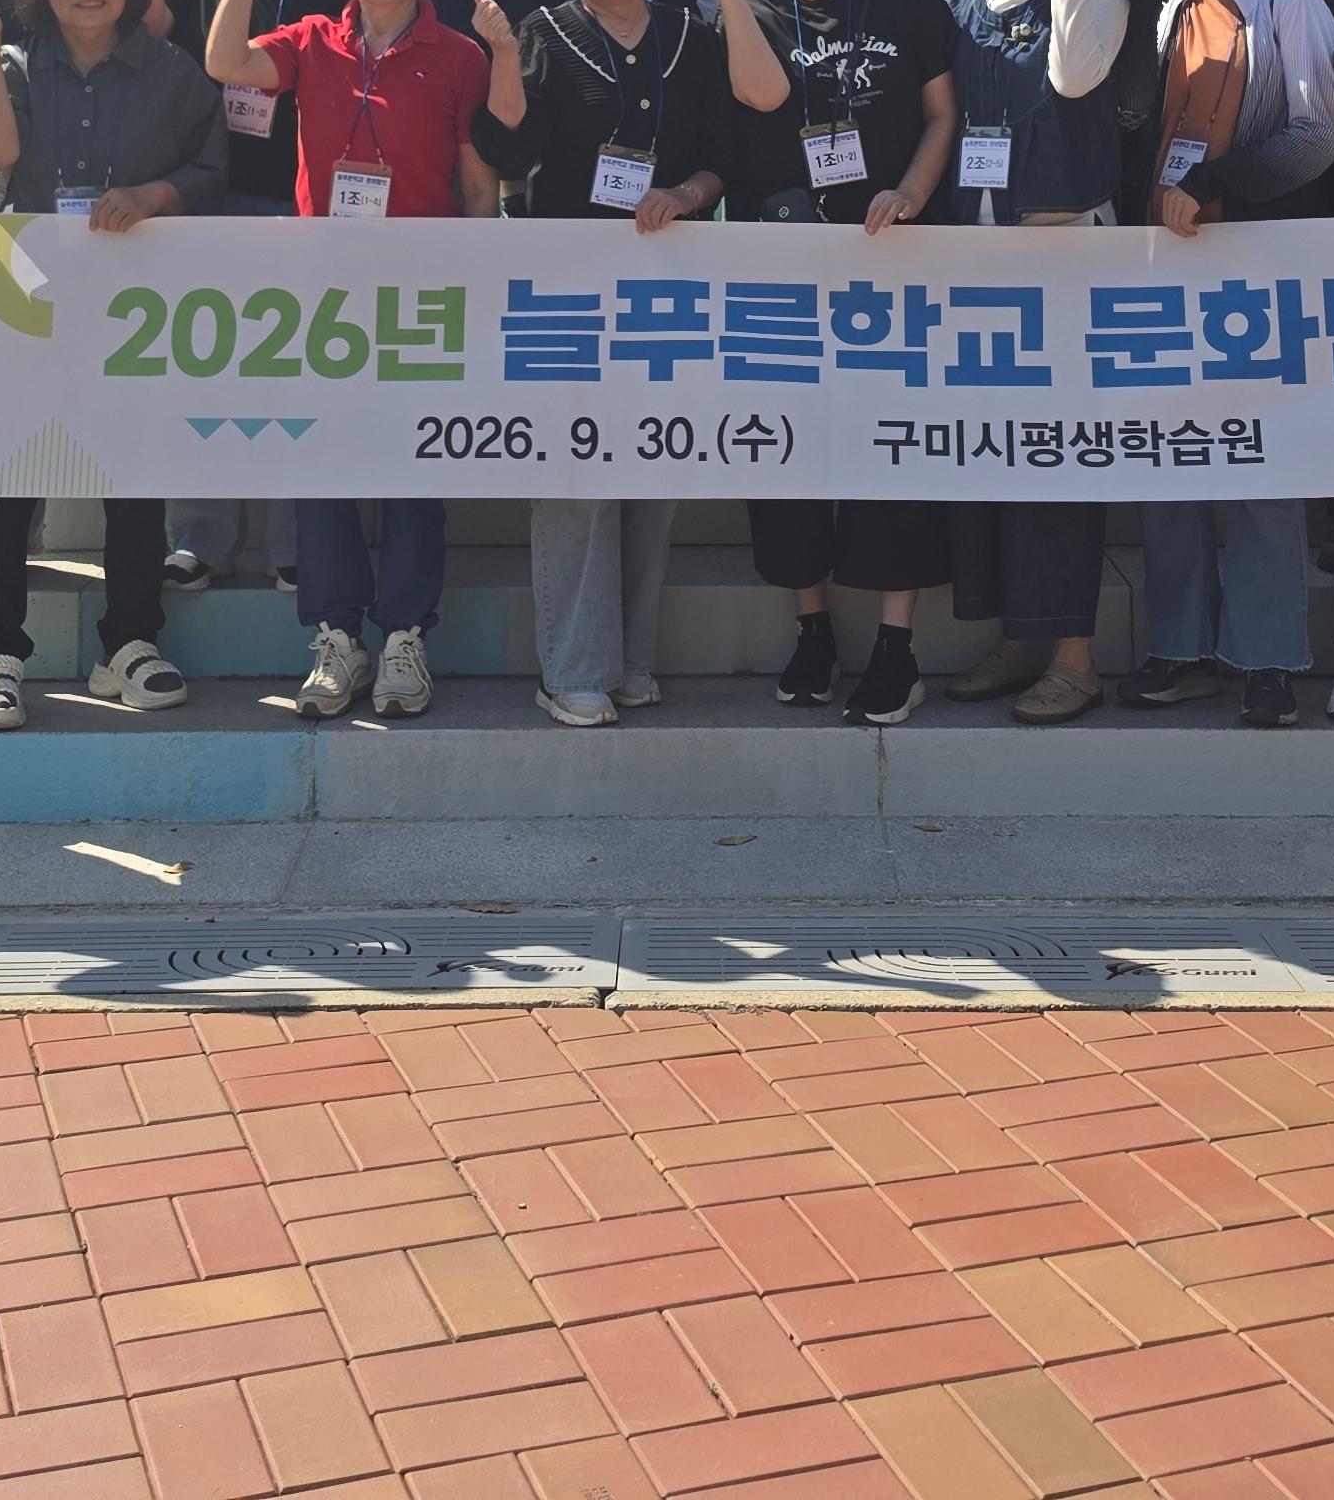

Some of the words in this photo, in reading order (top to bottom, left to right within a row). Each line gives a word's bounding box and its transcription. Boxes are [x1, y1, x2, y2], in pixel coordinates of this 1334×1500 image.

[104, 286, 466, 381] 2026년
[501, 279, 1052, 387] 늘푸른학교
[415, 416, 547, 462] 2026.
[571, 417, 613, 462] 9.
[637, 414, 794, 464] 30.(수)
[873, 418, 1265, 467] 구미시평생학습원
